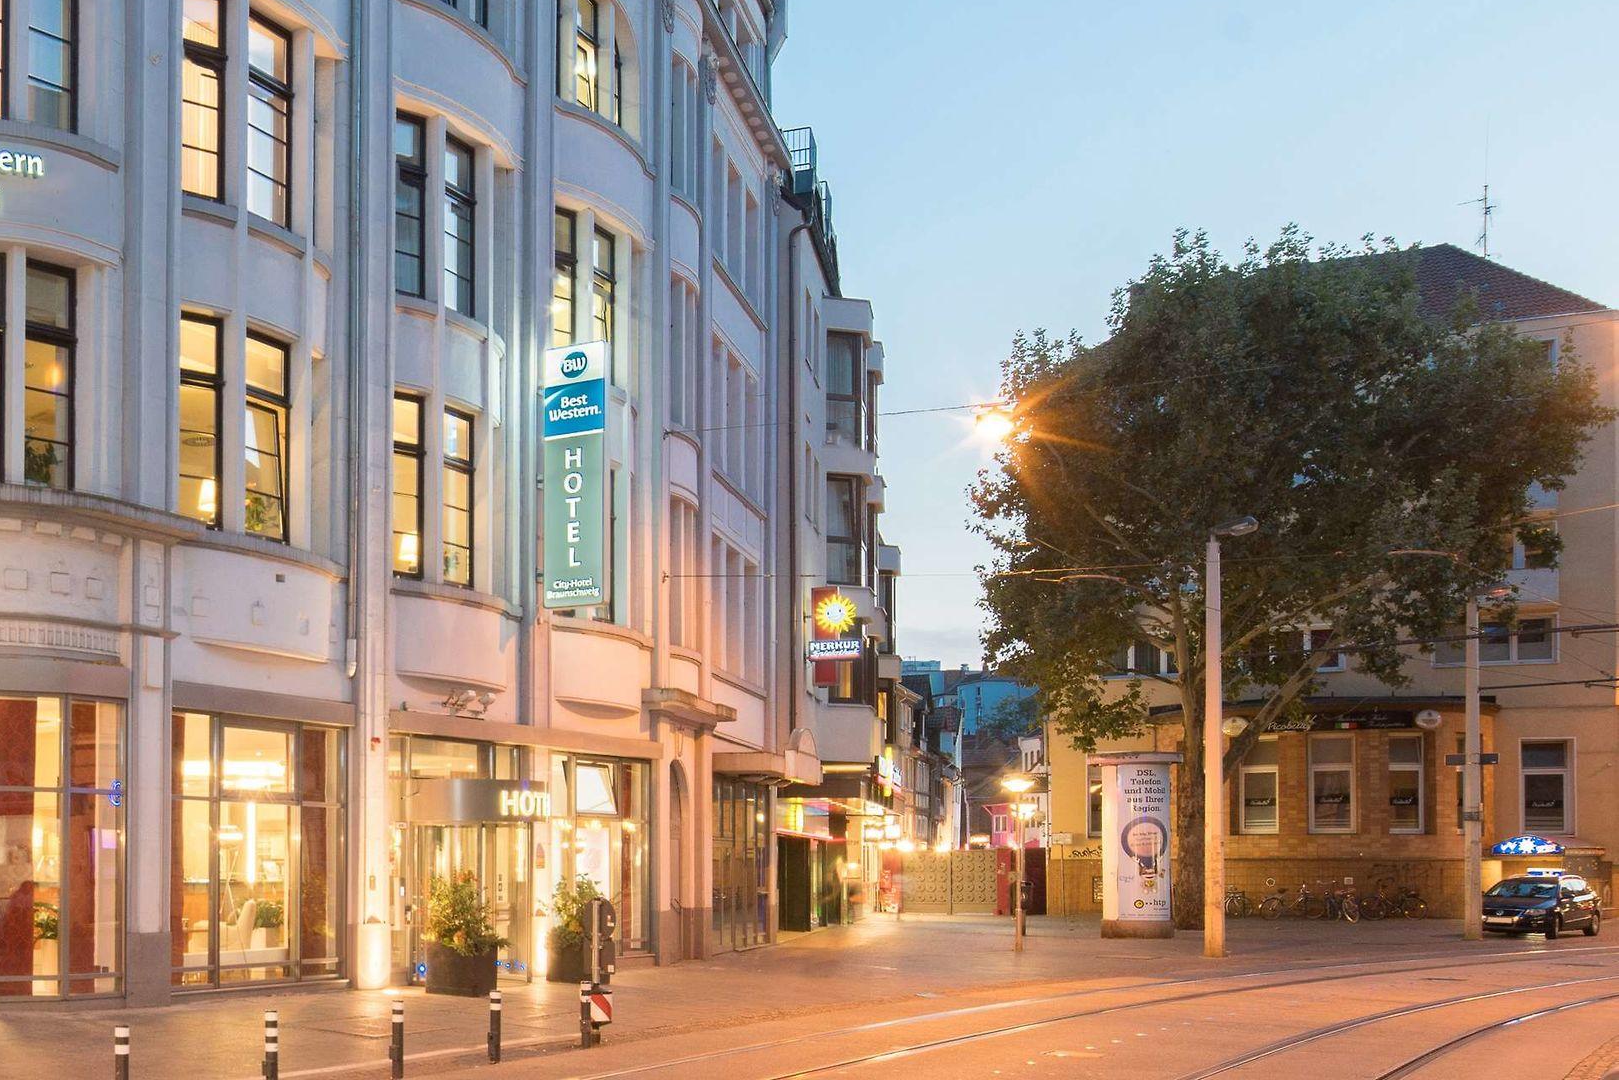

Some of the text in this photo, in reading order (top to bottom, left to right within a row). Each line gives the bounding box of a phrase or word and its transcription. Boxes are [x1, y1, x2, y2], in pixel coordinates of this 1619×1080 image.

[562, 354, 587, 372] BW
[560, 393, 587, 409] Best
[563, 446, 584, 568] HOTEL
[810, 640, 860, 651] MERKUR
[1153, 899, 1166, 907] htp
